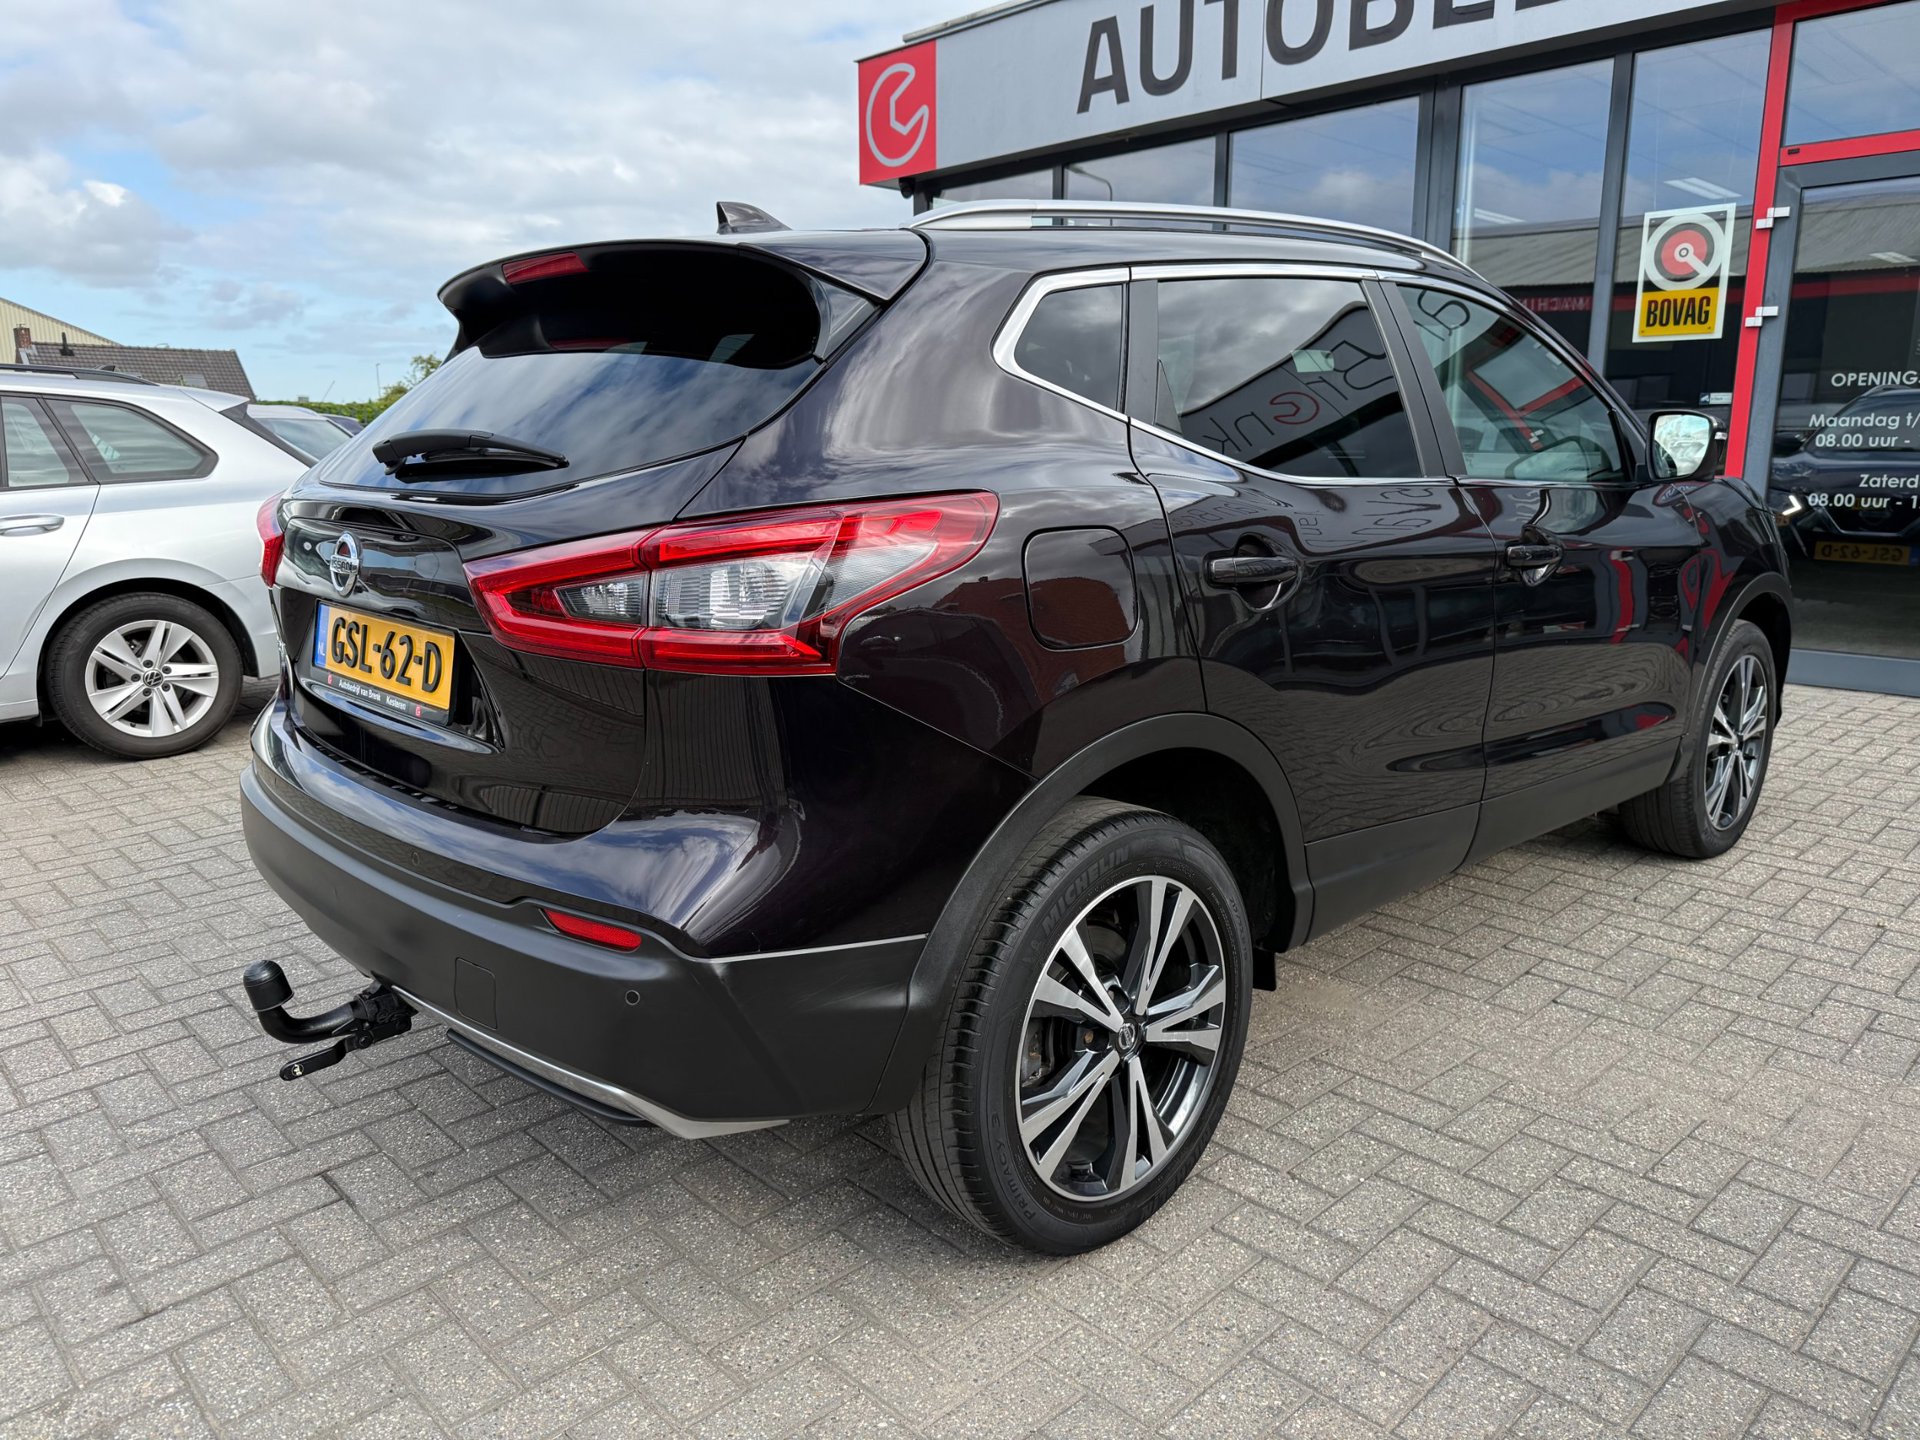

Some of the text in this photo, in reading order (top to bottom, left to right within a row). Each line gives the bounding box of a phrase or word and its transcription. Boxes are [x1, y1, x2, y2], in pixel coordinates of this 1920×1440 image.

[1077, 0, 1563, 114] AUTOB
[1645, 296, 1711, 328] BOVAG
[1831, 371, 1920, 387] OPENING
[1808, 413, 1900, 430] Maandag
[1815, 434, 1863, 447] 08.00
[1868, 436, 1898, 447] uur
[1807, 493, 1855, 507] 08.00
[1861, 497, 1890, 508] uur
[331, 616, 442, 693] GSL-62-D
